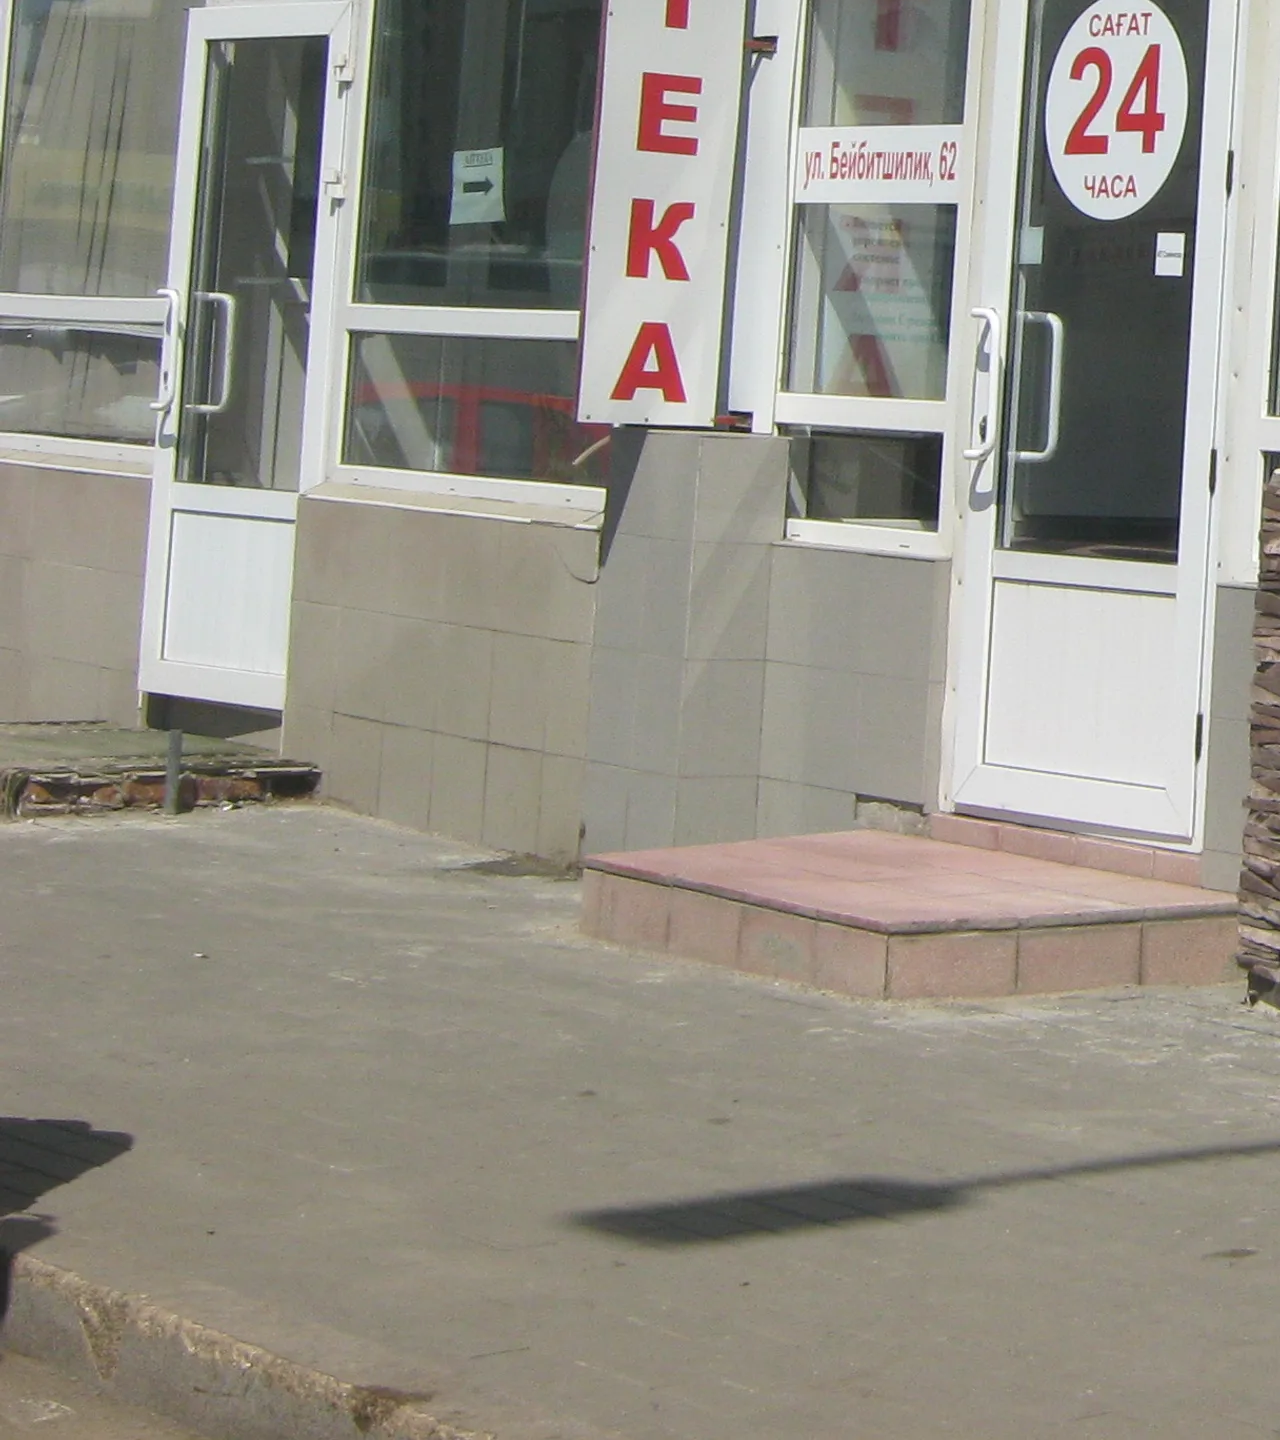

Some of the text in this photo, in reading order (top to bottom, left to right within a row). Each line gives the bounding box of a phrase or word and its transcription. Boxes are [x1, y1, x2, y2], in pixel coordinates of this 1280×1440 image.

[1089, 12, 1152, 37] САҒАТ
[1063, 44, 1166, 155] 24
[803, 151, 825, 190] ул.
[938, 141, 957, 180] 62
[1084, 175, 1137, 198] ЧАСА
